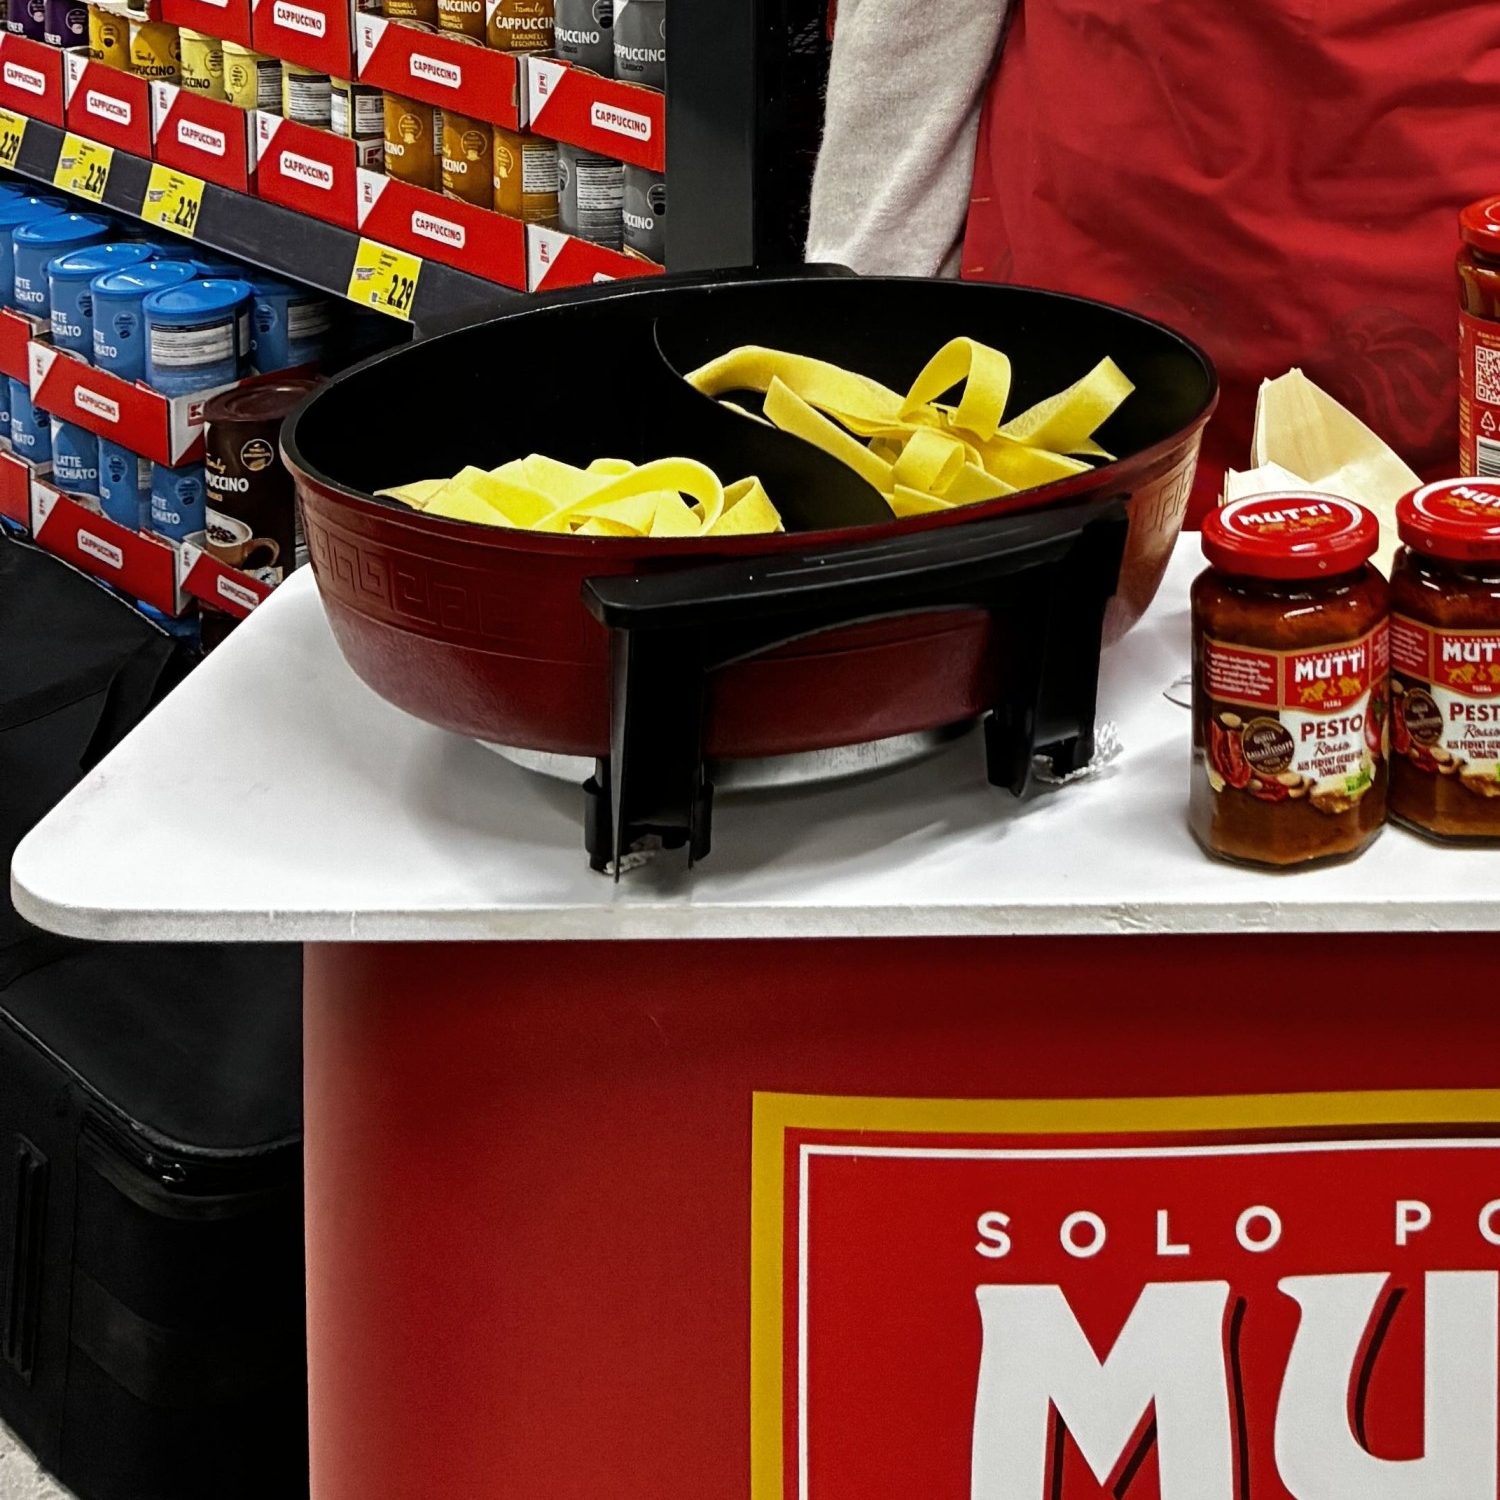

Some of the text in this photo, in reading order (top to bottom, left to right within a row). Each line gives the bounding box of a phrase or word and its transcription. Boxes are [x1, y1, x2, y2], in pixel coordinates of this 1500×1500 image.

[277, 9, 321, 29] CAPPUCCINO
[512, 2, 544, 15] Family
[7, 68, 41, 88] CAPPUCCINO
[414, 61, 457, 81] CAPPUCCINO
[89, 97, 128, 118] CAPPUCCINO
[596, 110, 647, 133] CAPPUCCINO
[181, 127, 222, 148] CAPPUCCINO
[283, 158, 329, 182] CAPPUCCINO
[416, 218, 461, 240] CAPPUCCINO
[387, 274, 414, 309] 2.29
[1238, 503, 1331, 526] MUTTI
[1295, 648, 1365, 683] MUTTI
[1301, 714, 1363, 742] PESTO
[1464, 724, 1500, 739] Rosso
[1314, 740, 1350, 756] Rosso
[974, 1204, 1283, 1258] SOLO
